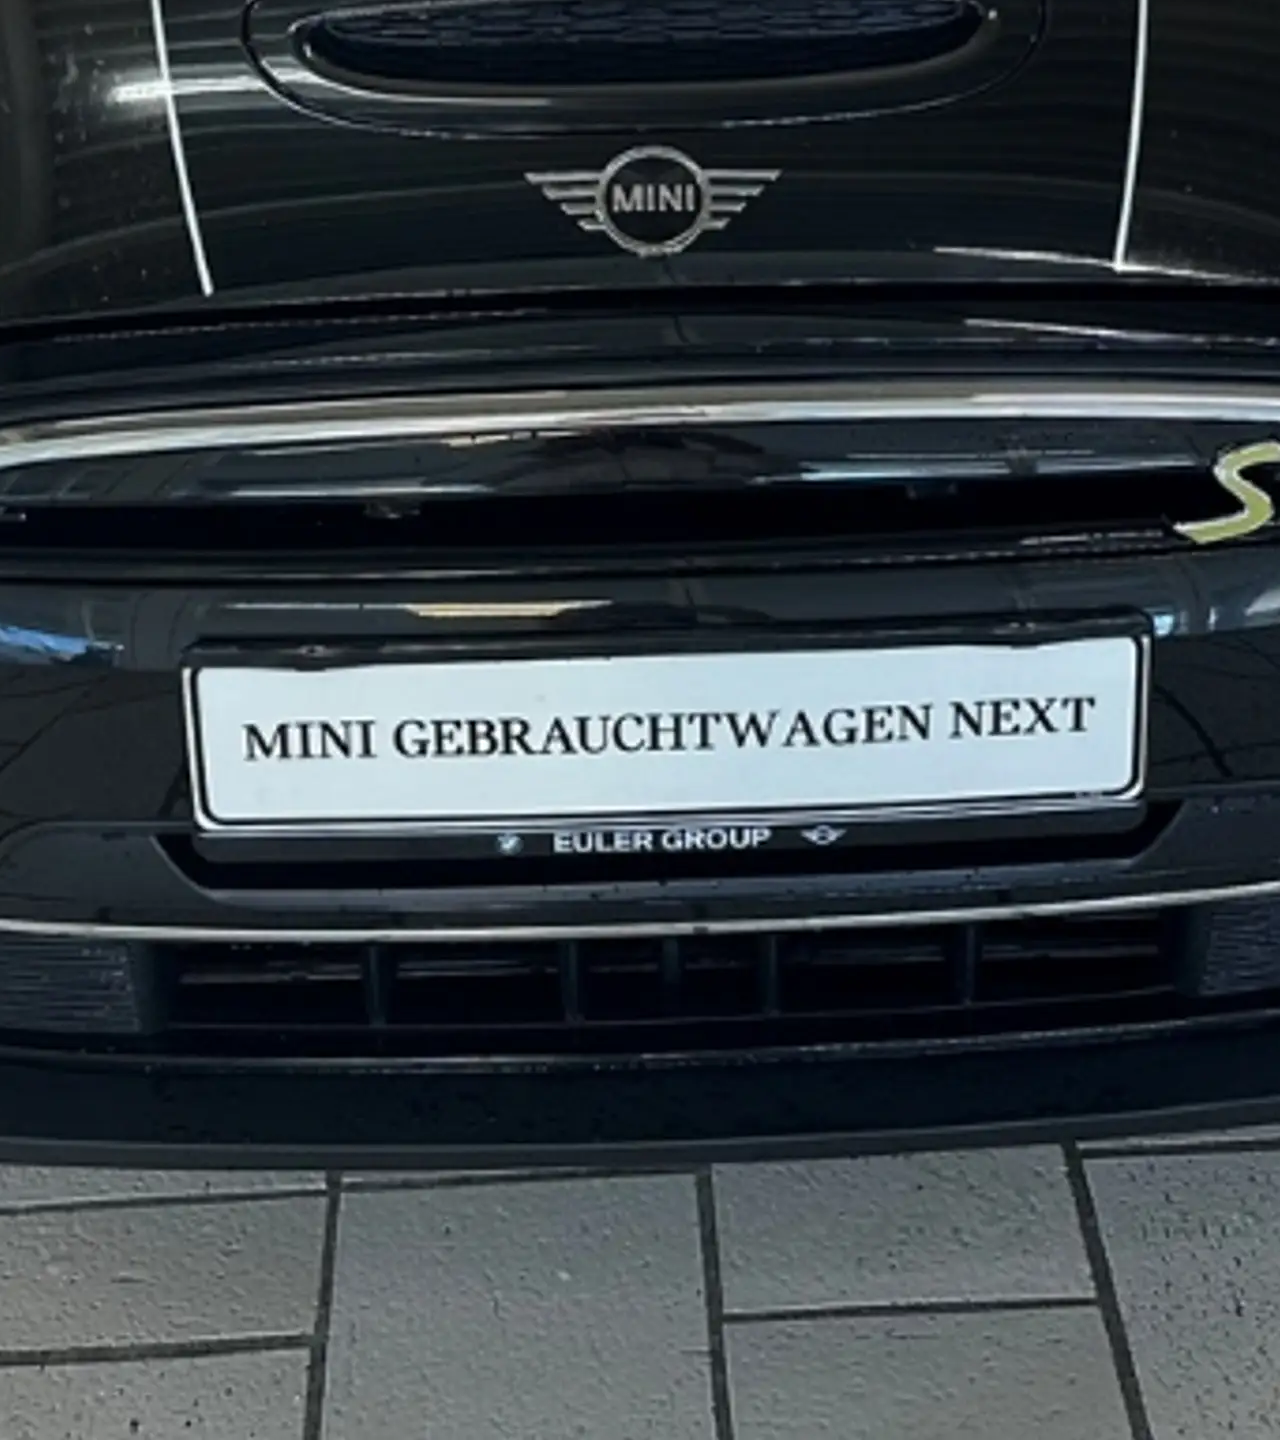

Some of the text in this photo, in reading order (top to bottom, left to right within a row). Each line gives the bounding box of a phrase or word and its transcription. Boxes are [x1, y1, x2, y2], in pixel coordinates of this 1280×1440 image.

[611, 182, 697, 214] MINI
[242, 695, 1097, 762] MINI GEBRAUCHTWAGEN NEXT
[552, 826, 773, 854] EULER GROUP
